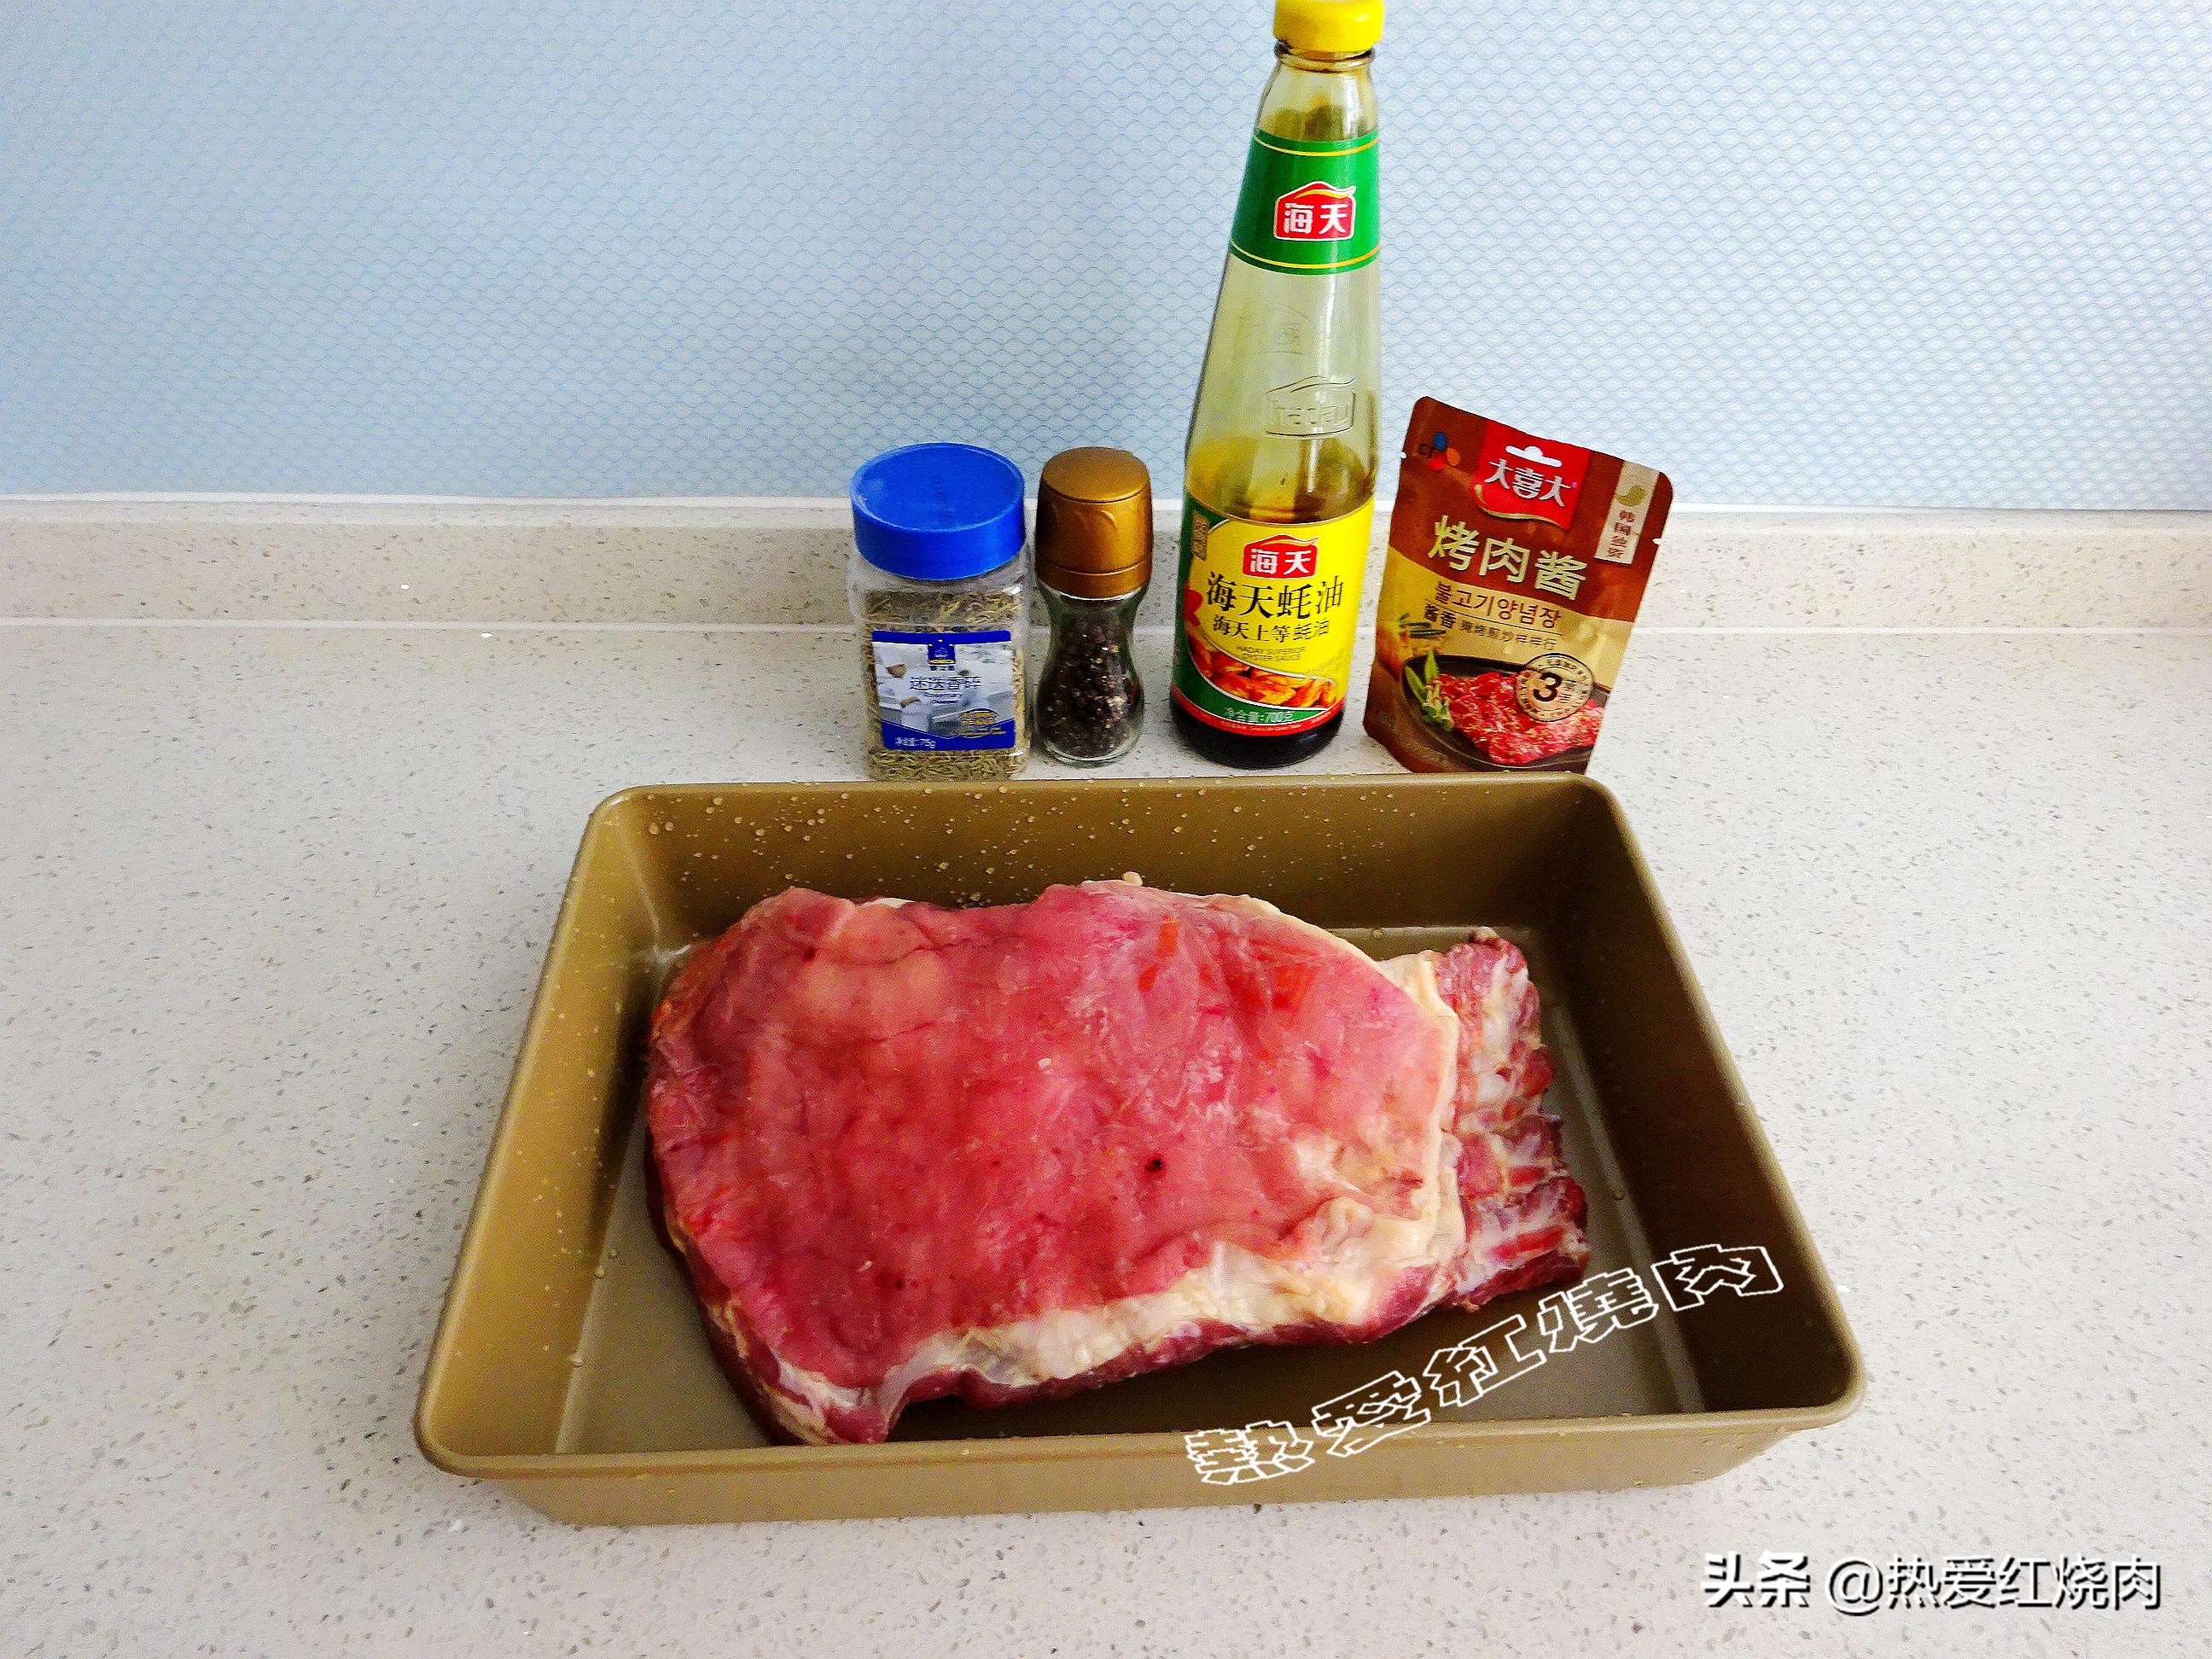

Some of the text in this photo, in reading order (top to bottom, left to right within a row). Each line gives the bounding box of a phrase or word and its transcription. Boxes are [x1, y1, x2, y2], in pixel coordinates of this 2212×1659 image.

[1284, 201, 1348, 235] 海天
[1485, 458, 1571, 507] 大喜大
[1250, 548, 1312, 574] 海天
[1428, 515, 1587, 599] 烤肉酱
[1206, 571, 1344, 619] 海天蚝油
[1435, 581, 1561, 629] 불고기양념장
[1533, 672, 1562, 701] 3
